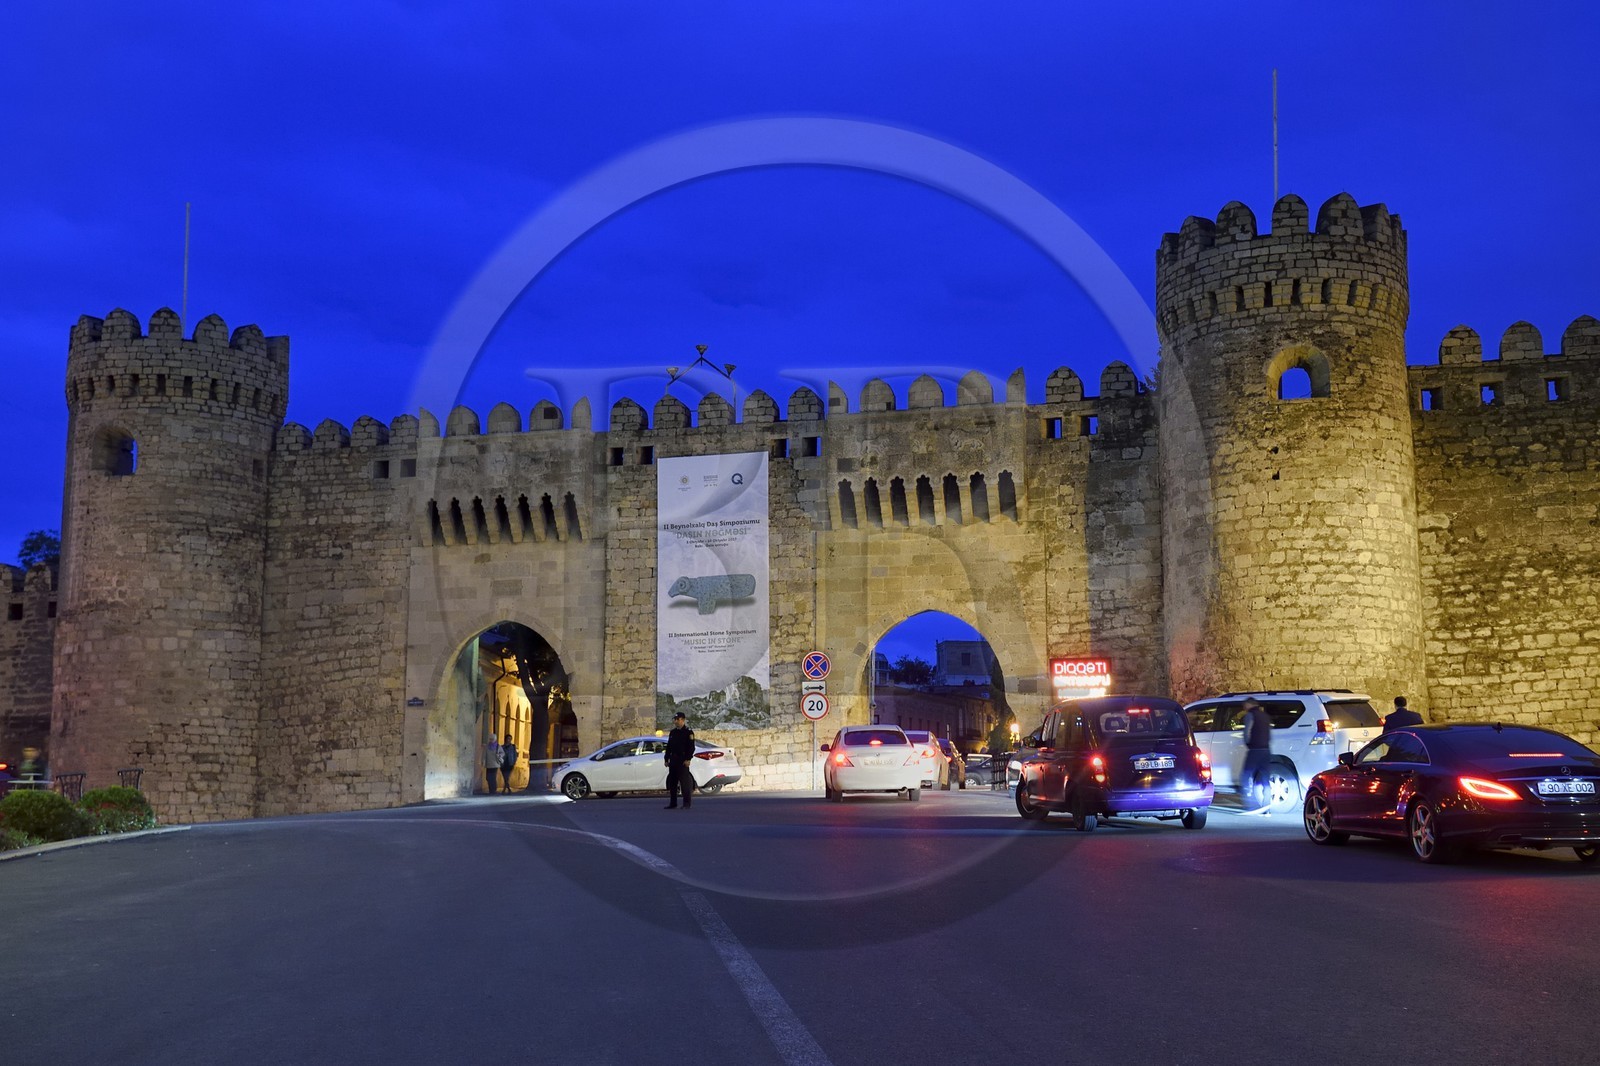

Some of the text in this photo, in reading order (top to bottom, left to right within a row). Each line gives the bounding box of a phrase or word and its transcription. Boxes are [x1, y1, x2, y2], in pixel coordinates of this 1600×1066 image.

[731, 472, 744, 485] Q
[670, 522, 705, 531] Beynəlxalq
[719, 519, 760, 528] Simpoziumu
[807, 699, 824, 711] 20
